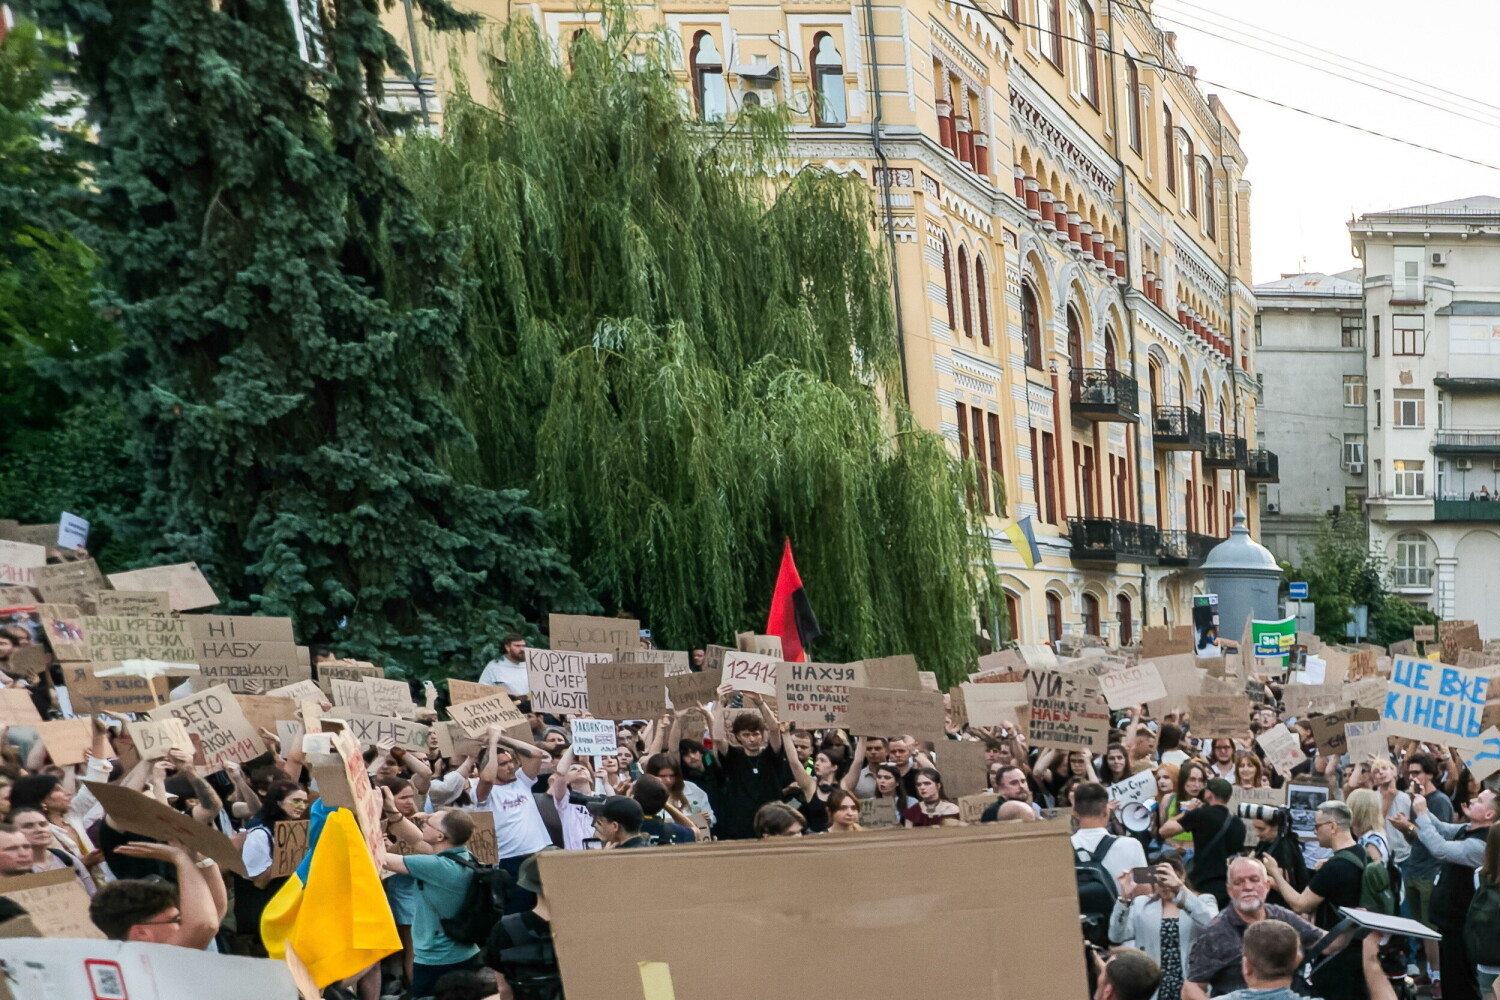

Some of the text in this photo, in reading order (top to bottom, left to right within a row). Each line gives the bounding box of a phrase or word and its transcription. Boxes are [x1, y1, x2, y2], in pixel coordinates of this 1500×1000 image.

[126, 619, 186, 633] КРЕДИТ
[208, 619, 236, 637] НІ
[146, 633, 185, 647] СУКА
[203, 642, 261, 658] НАБУ
[791, 665, 856, 681] НАХУЯ
[786, 683, 849, 694] МЕНІ СИСТЕ
[1393, 659, 1491, 705] ЦЕ ВЖЕ
[786, 693, 805, 702] ЩО
[171, 694, 223, 727] ВЕТО
[788, 703, 849, 713] ПРОТИ МЕ
[1031, 708, 1072, 722] НАБУ
[1384, 691, 1482, 739] КІНЕЦЬ
[197, 723, 220, 737] НА
[377, 722, 406, 744] НЕ
